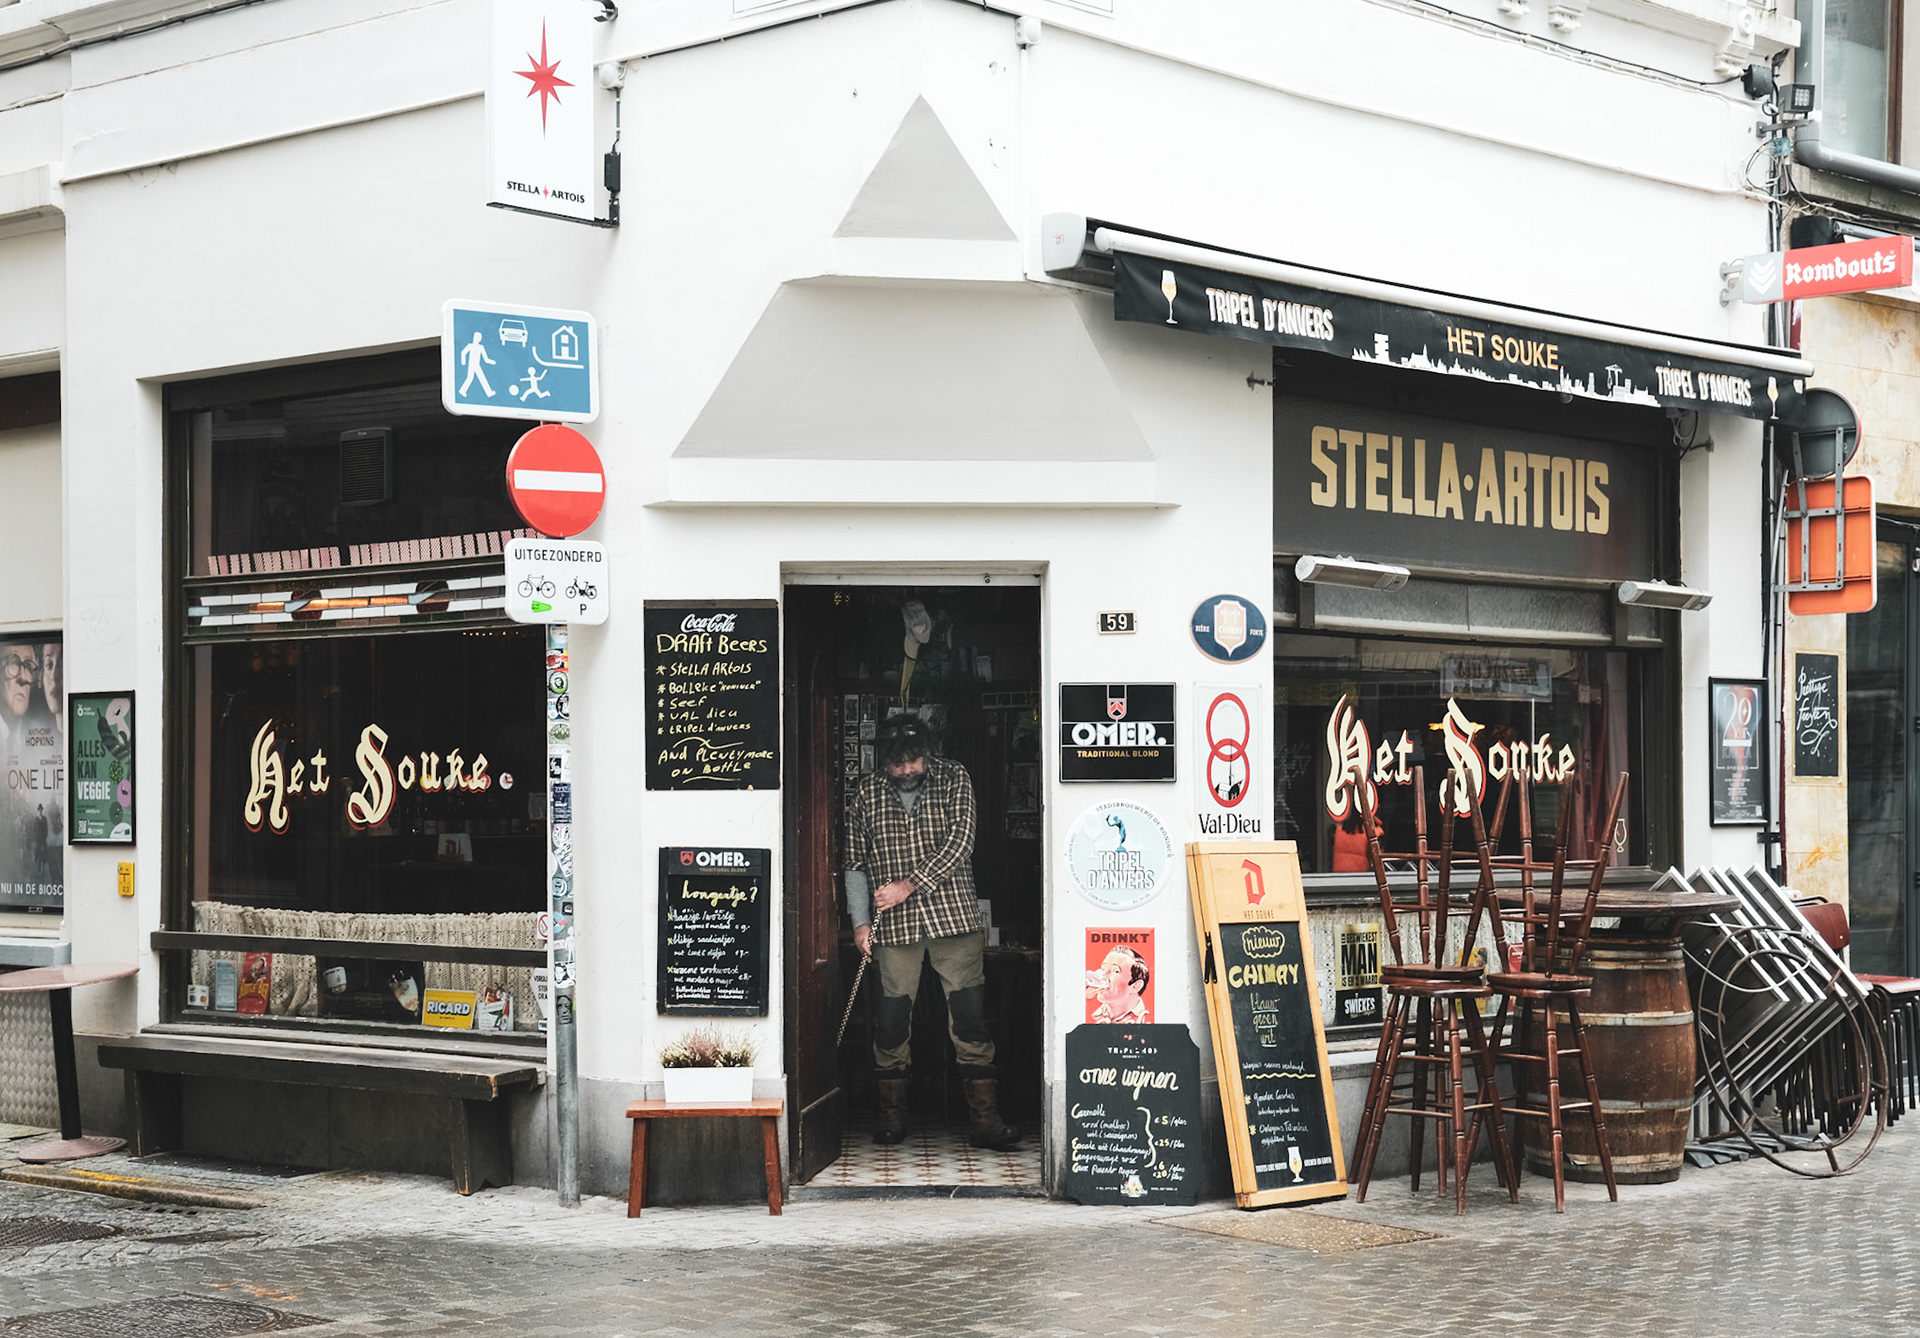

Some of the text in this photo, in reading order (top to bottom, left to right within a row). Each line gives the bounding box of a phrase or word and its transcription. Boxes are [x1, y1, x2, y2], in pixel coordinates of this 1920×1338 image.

[506, 180, 585, 203] STELLA ARTOIS
[1785, 250, 1897, 286] Rombouts
[1205, 287, 1334, 342] TRIPEL D'ANVERS
[1446, 326, 1559, 371] HET SOUKE
[1655, 365, 1752, 407] TRIPEL D'ANVERS
[514, 548, 602, 563] UITGEZONDERD
[579, 603, 588, 616] P
[1106, 613, 1128, 631] 59
[1794, 666, 1832, 701] Prettige
[28, 728, 52, 736] ANTHONY
[1071, 721, 1167, 746] OMER.
[25, 737, 54, 747] HOPKINS
[77, 740, 106, 758] ALLES
[1076, 750, 1160, 758] TRADITIONAL BLOND
[77, 761, 97, 779] KAN
[243, 718, 330, 834] Het
[8, 769, 39, 790] ONE
[77, 781, 111, 800] VEGGIE
[695, 851, 751, 867] OMER.
[1097, 850, 1145, 872] TRIPEL
[1, 883, 12, 894] NU
[14, 883, 23, 895] IN
[26, 883, 36, 895] DE
[1087, 869, 1155, 891] D'ANVERS
[1090, 932, 1150, 943] DRINKT
[1341, 943, 1378, 976] MAN
[1341, 976, 1347, 988] IS
[1347, 976, 1354, 987] ER
[426, 1000, 472, 1017] RICARD
